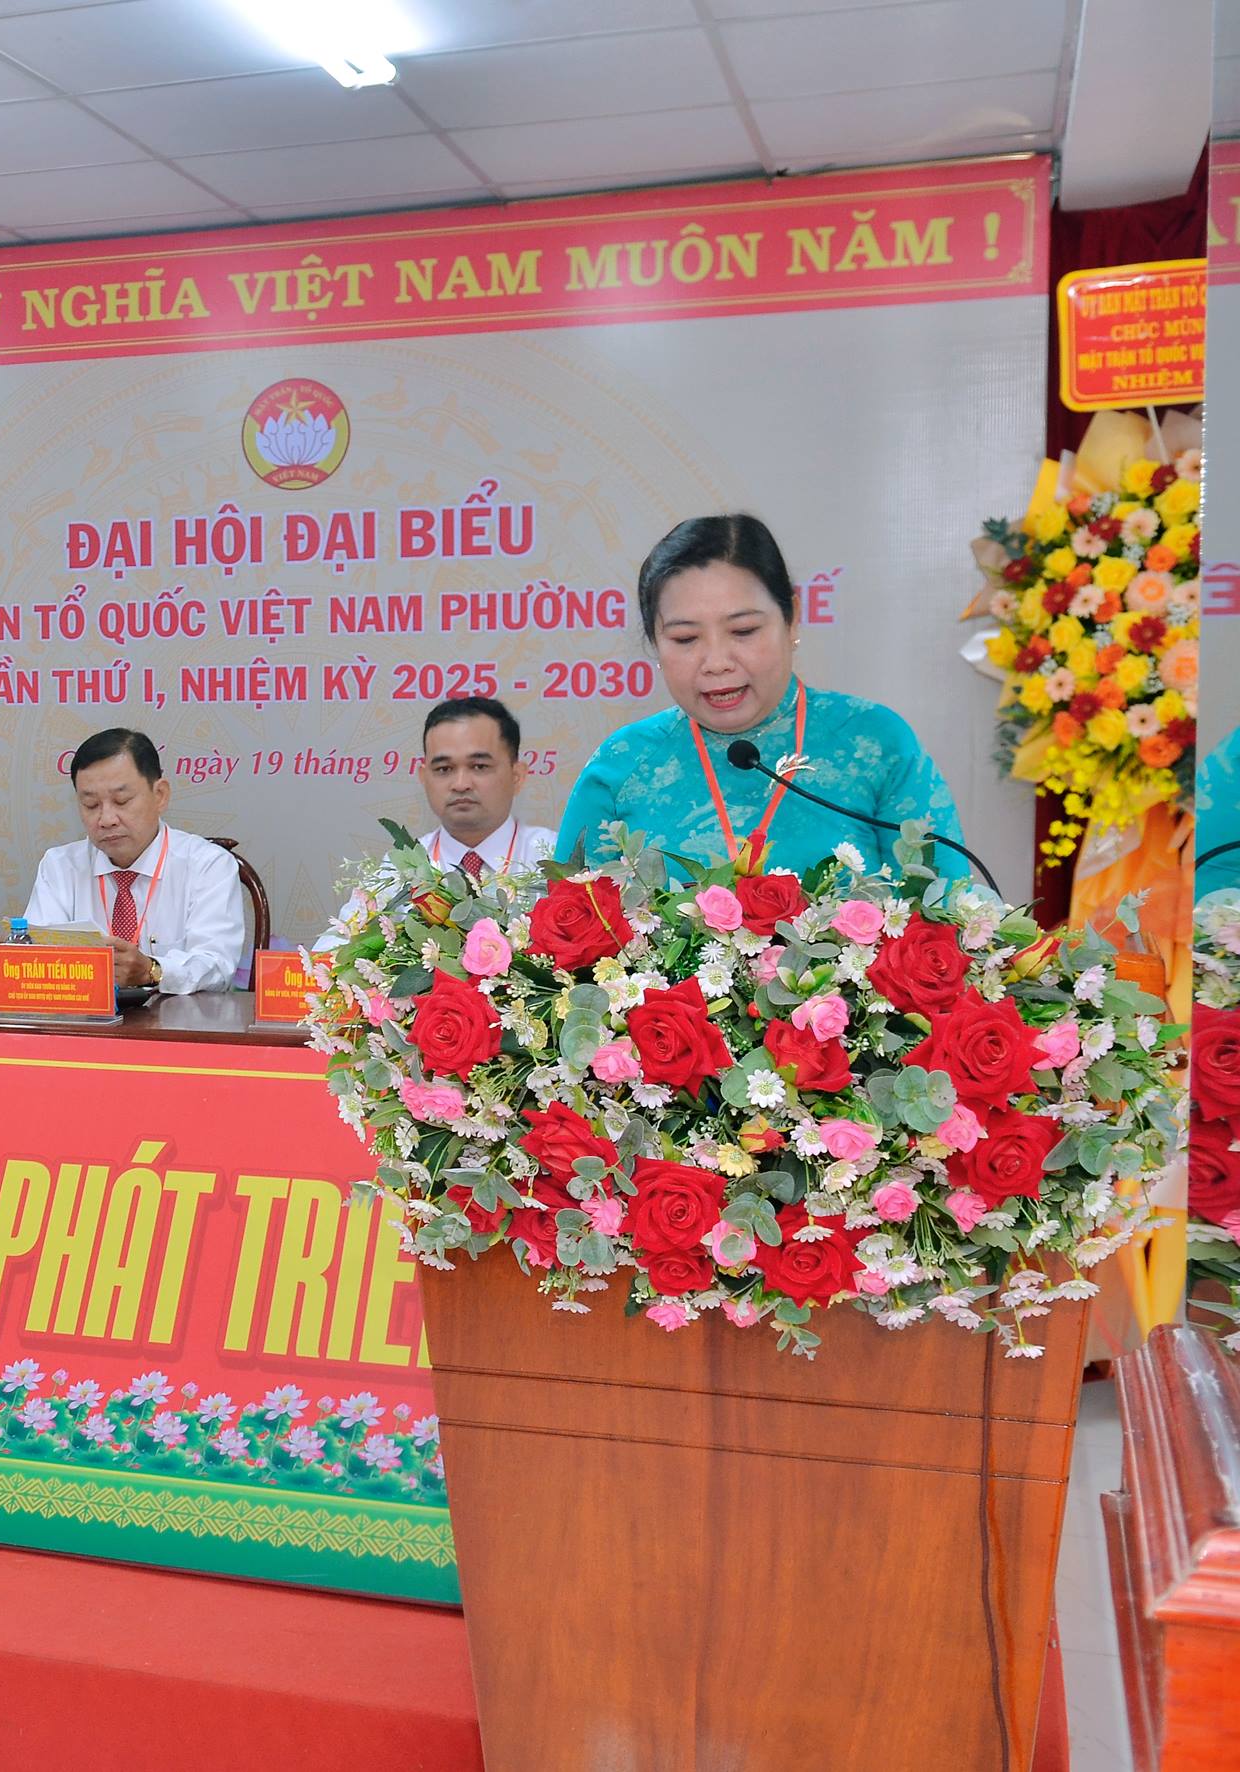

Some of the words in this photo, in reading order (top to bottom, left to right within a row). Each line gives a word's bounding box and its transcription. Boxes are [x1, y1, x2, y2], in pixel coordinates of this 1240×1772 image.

[21, 267, 210, 331] NGHĨA
[229, 253, 374, 321] VIỆT
[395, 249, 543, 305] NAM
[565, 222, 762, 291] MUÔN
[786, 210, 954, 275] NĂM
[983, 212, 1001, 261] !
[65, 521, 153, 579] ĐẠI
[174, 503, 263, 577] HỘI
[283, 511, 377, 573] ĐẠI
[399, 477, 534, 559] BIỂU
[33, 584, 87, 642] TỔ
[97, 586, 207, 646] QUỐC
[220, 588, 312, 644] VIỆT
[329, 594, 422, 634] NAM
[440, 580, 627, 632] PHƯỜNG
[51, 659, 132, 704] THỨ
[144, 669, 166, 710] I,
[180, 657, 308, 711] NHIỆM
[323, 654, 378, 701] KỲ
[392, 662, 499, 701] 2025
[513, 680, 528, 691] -
[542, 660, 654, 699] 2030
[175, 753, 241, 782] ngày
[251, 751, 284, 776] 19
[294, 747, 372, 782] tháng
[382, 750, 401, 777] 9
[523, 750, 559, 777] 25
[3, 959, 20, 980] Ông
[284, 966, 303, 988] Ông
